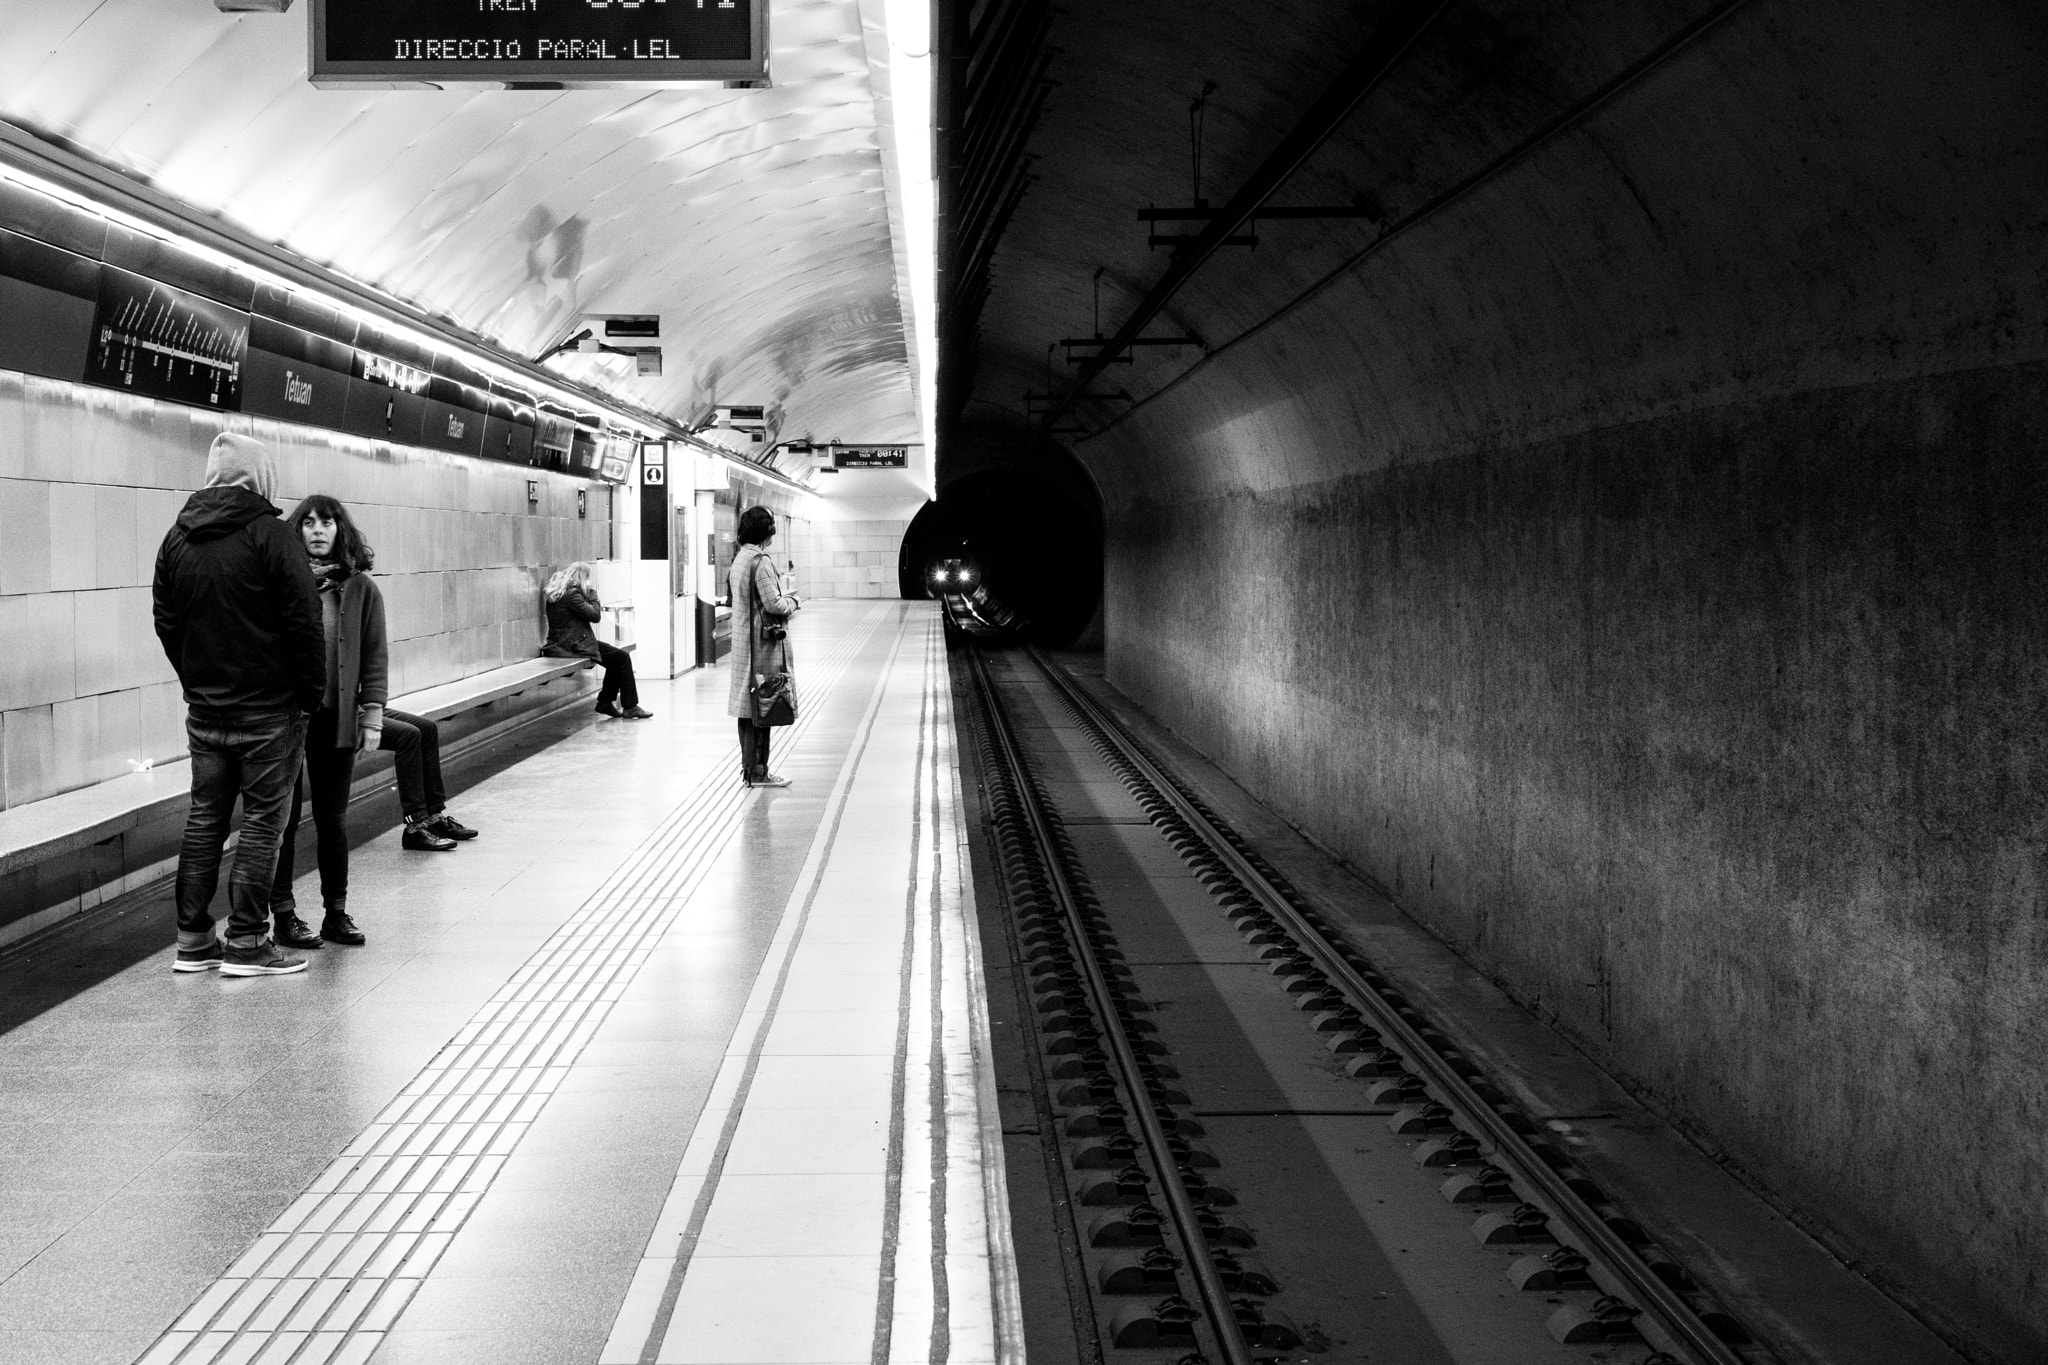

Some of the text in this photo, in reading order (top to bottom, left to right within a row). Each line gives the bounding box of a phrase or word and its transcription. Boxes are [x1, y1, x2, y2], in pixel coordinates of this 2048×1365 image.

[284, 370, 312, 405] Tetuan
[447, 413, 464, 439] Tetuan
[877, 449, 903, 457] 00:41
